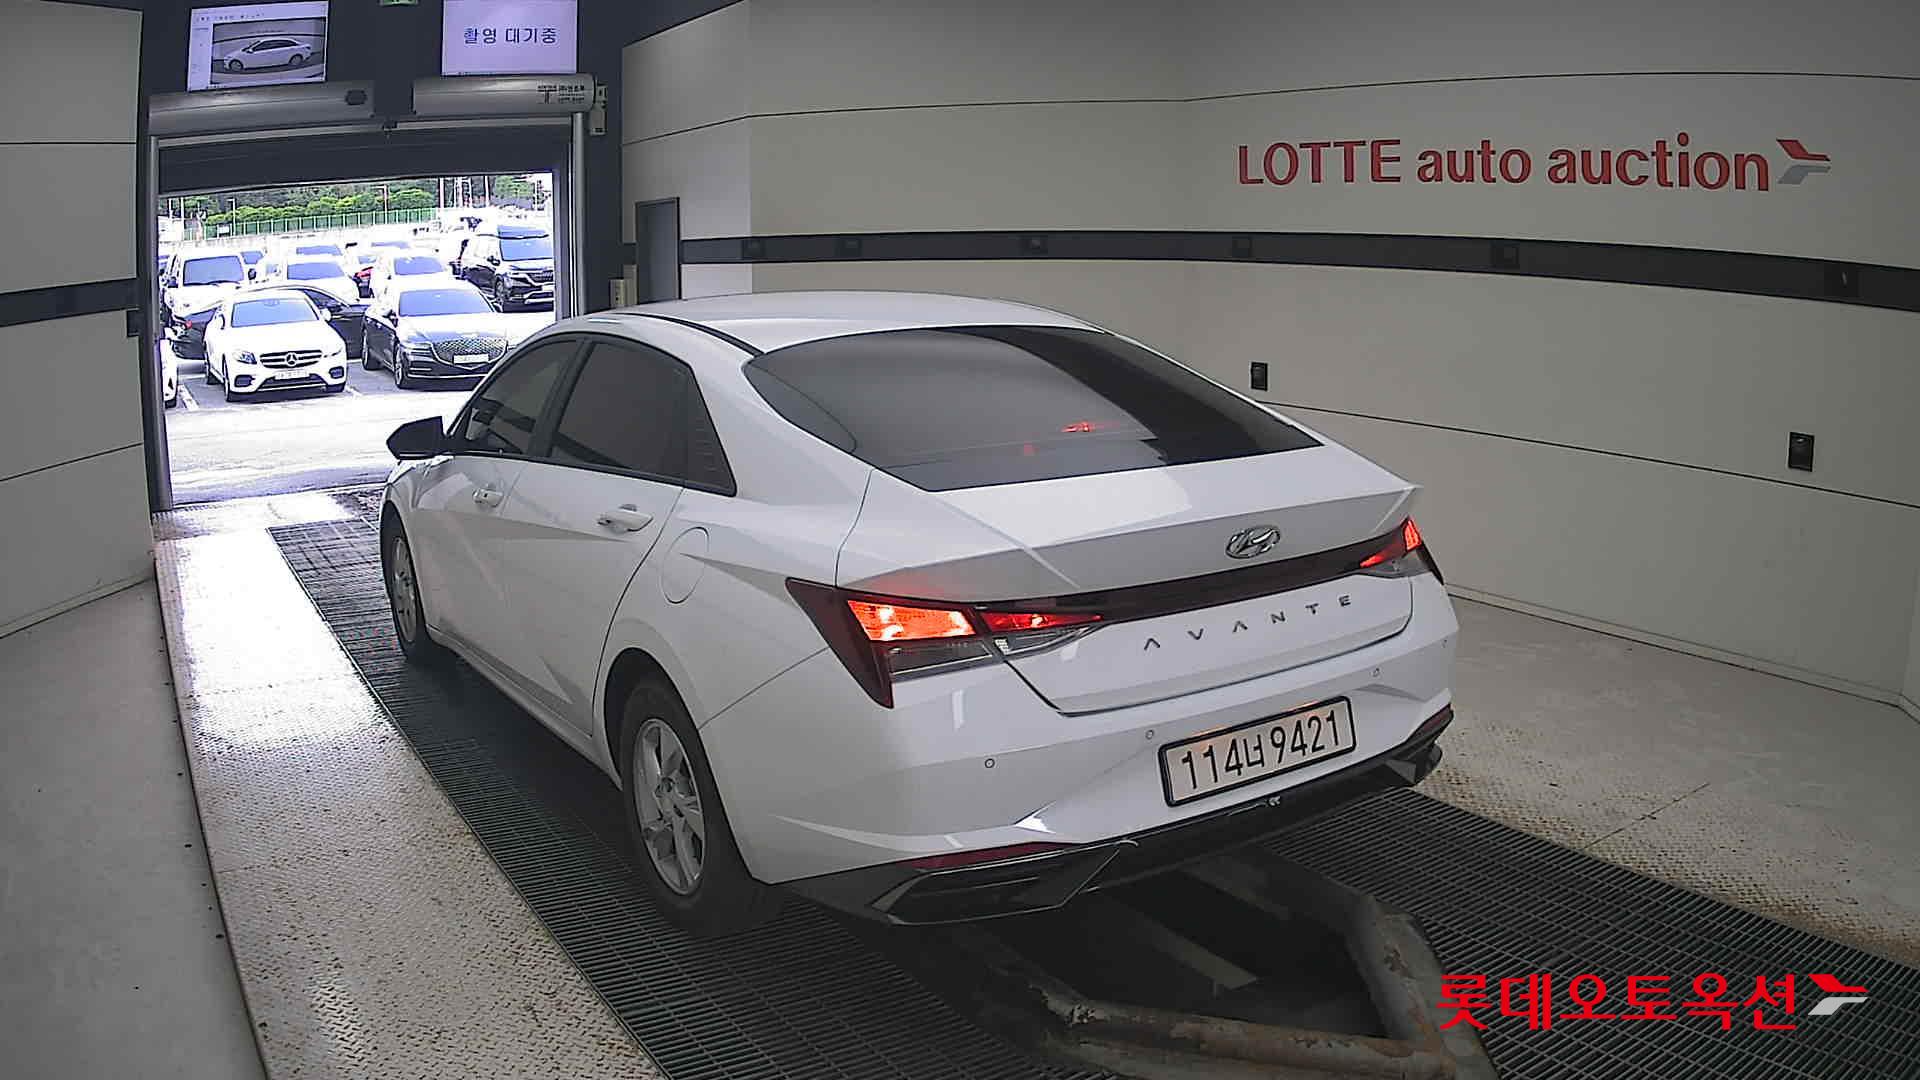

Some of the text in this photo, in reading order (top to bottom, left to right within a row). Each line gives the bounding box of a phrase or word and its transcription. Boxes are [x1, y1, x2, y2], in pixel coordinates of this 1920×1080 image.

[463, 27, 557, 44] 촬영 대기중
[1239, 132, 1770, 191] LOTTE auto auction
[1143, 595, 1352, 650] AVANTE
